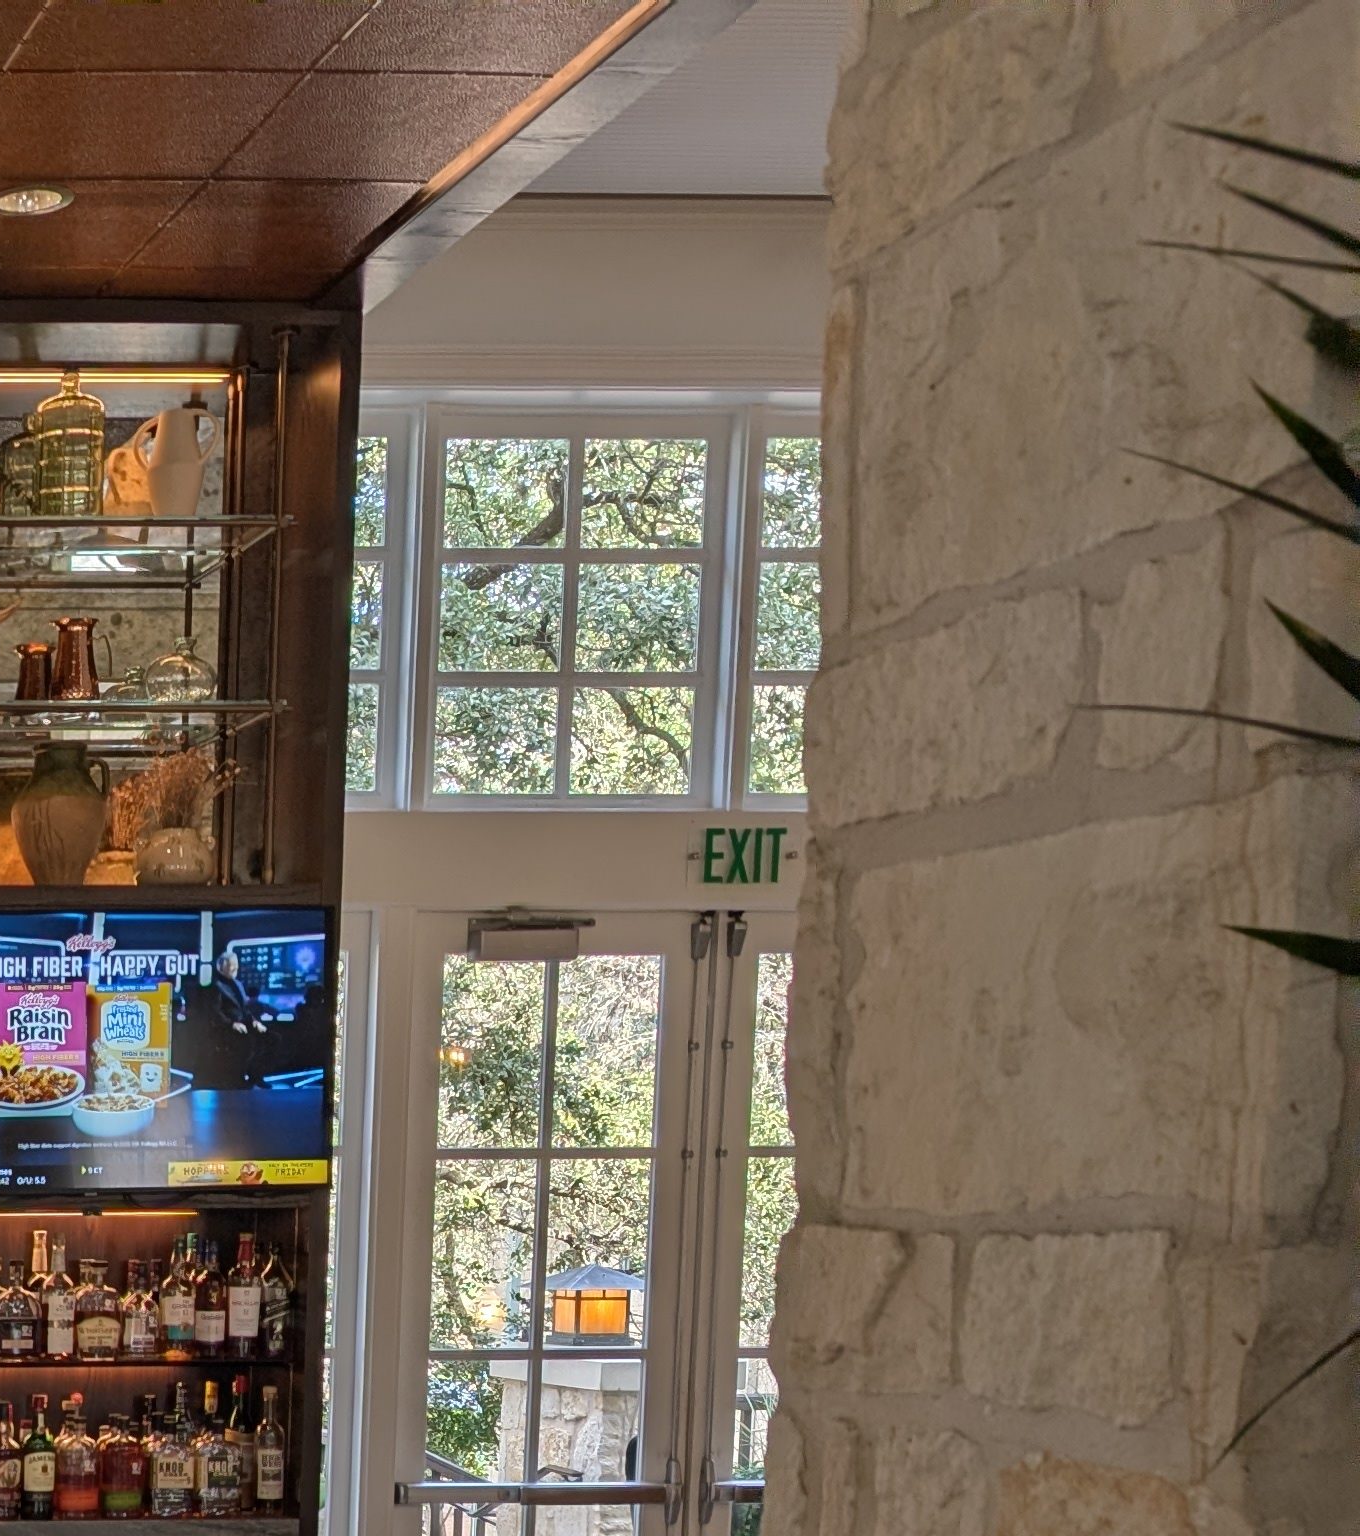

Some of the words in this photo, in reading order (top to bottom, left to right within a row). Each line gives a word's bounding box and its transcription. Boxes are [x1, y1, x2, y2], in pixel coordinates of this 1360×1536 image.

[703, 827, 788, 884] EXIT
[66, 933, 116, 952] Kellogg's
[32, 956, 83, 978] FIBER
[100, 955, 159, 976] HAPPY
[166, 954, 199, 976] GUT
[9, 1008, 69, 1027] Raisin
[106, 1011, 144, 1027] Mini
[17, 1025, 64, 1043] Bran
[104, 1025, 146, 1041] Wheats
[275, 1168, 306, 1177] FRIDAY
